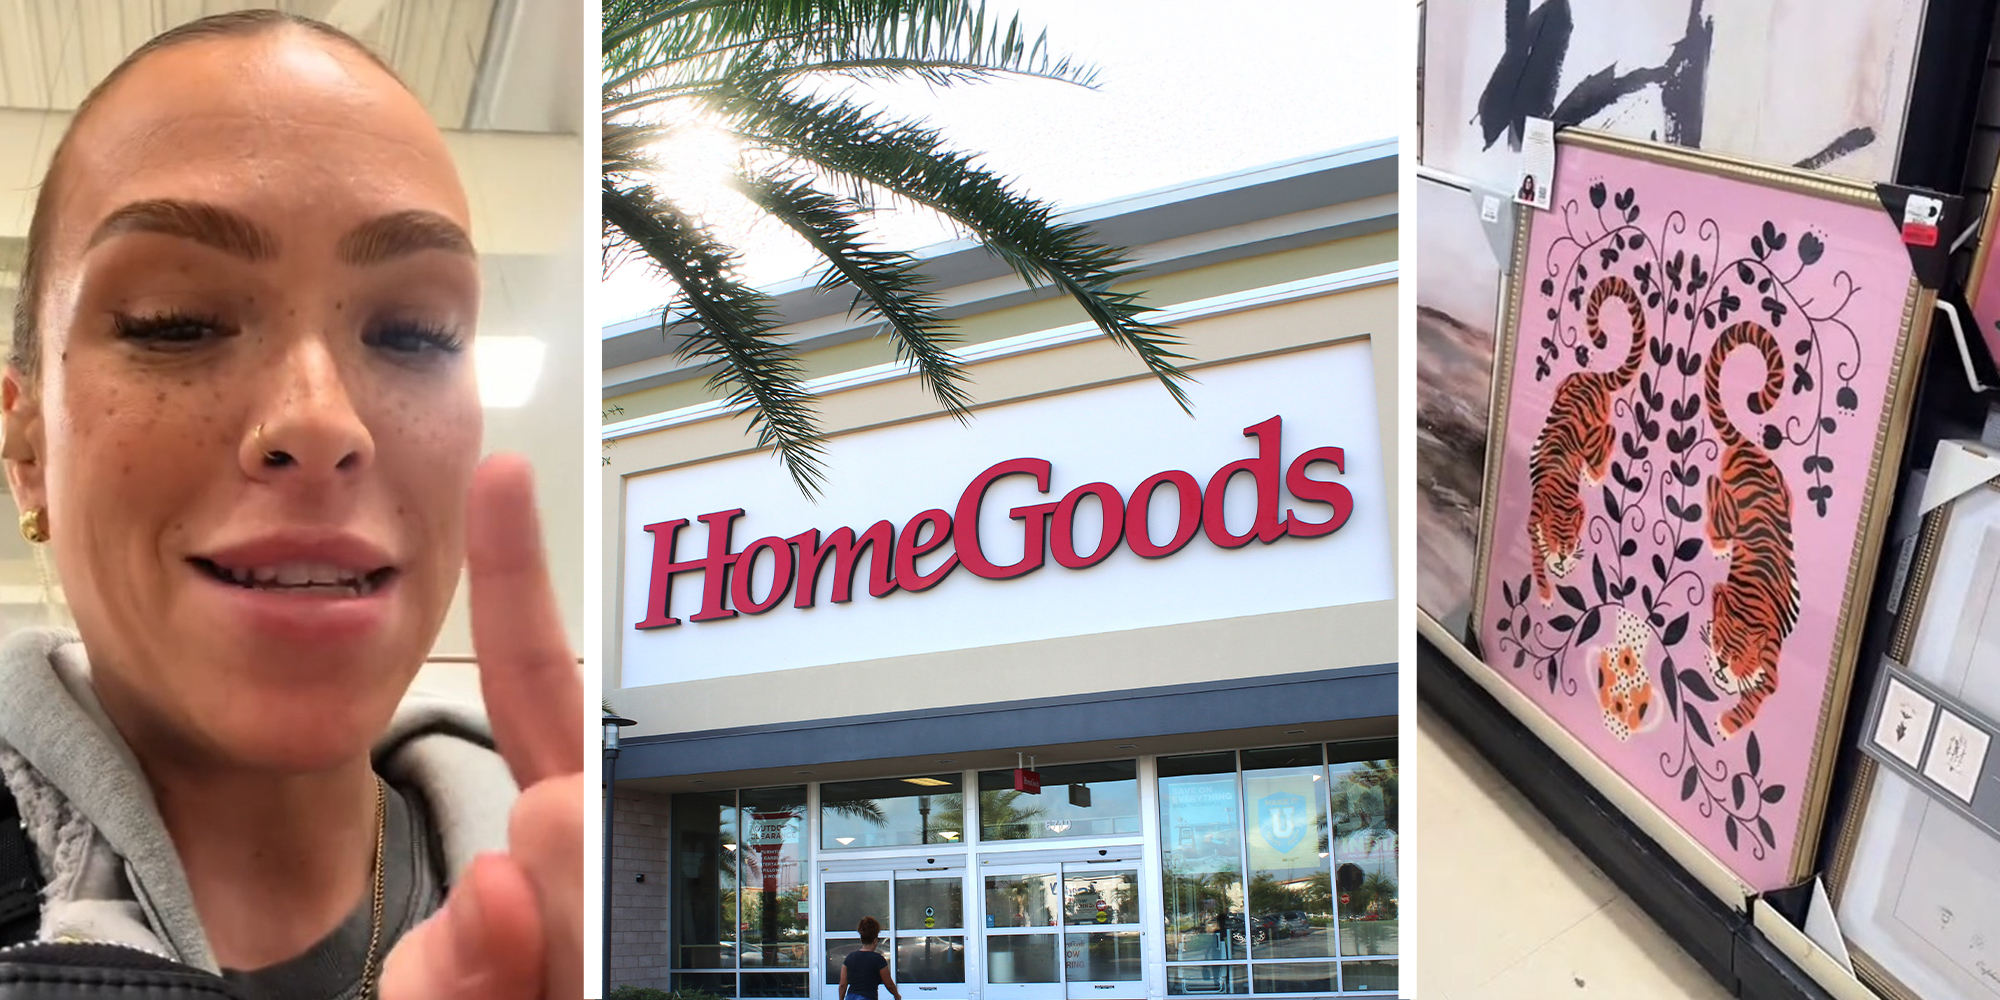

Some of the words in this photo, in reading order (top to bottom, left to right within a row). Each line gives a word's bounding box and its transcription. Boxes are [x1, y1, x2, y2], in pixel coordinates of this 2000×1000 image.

[635, 414, 1355, 631] HomeGoods
[1172, 787, 1197, 796] SAVE
[1198, 786, 1213, 794] ON
[1172, 792, 1233, 803] EVERYTHING
[1265, 798, 1289, 806] MAKE
[1269, 806, 1295, 839] U
[1066, 950, 1080, 958] OW
[1059, 960, 1085, 969] RING
